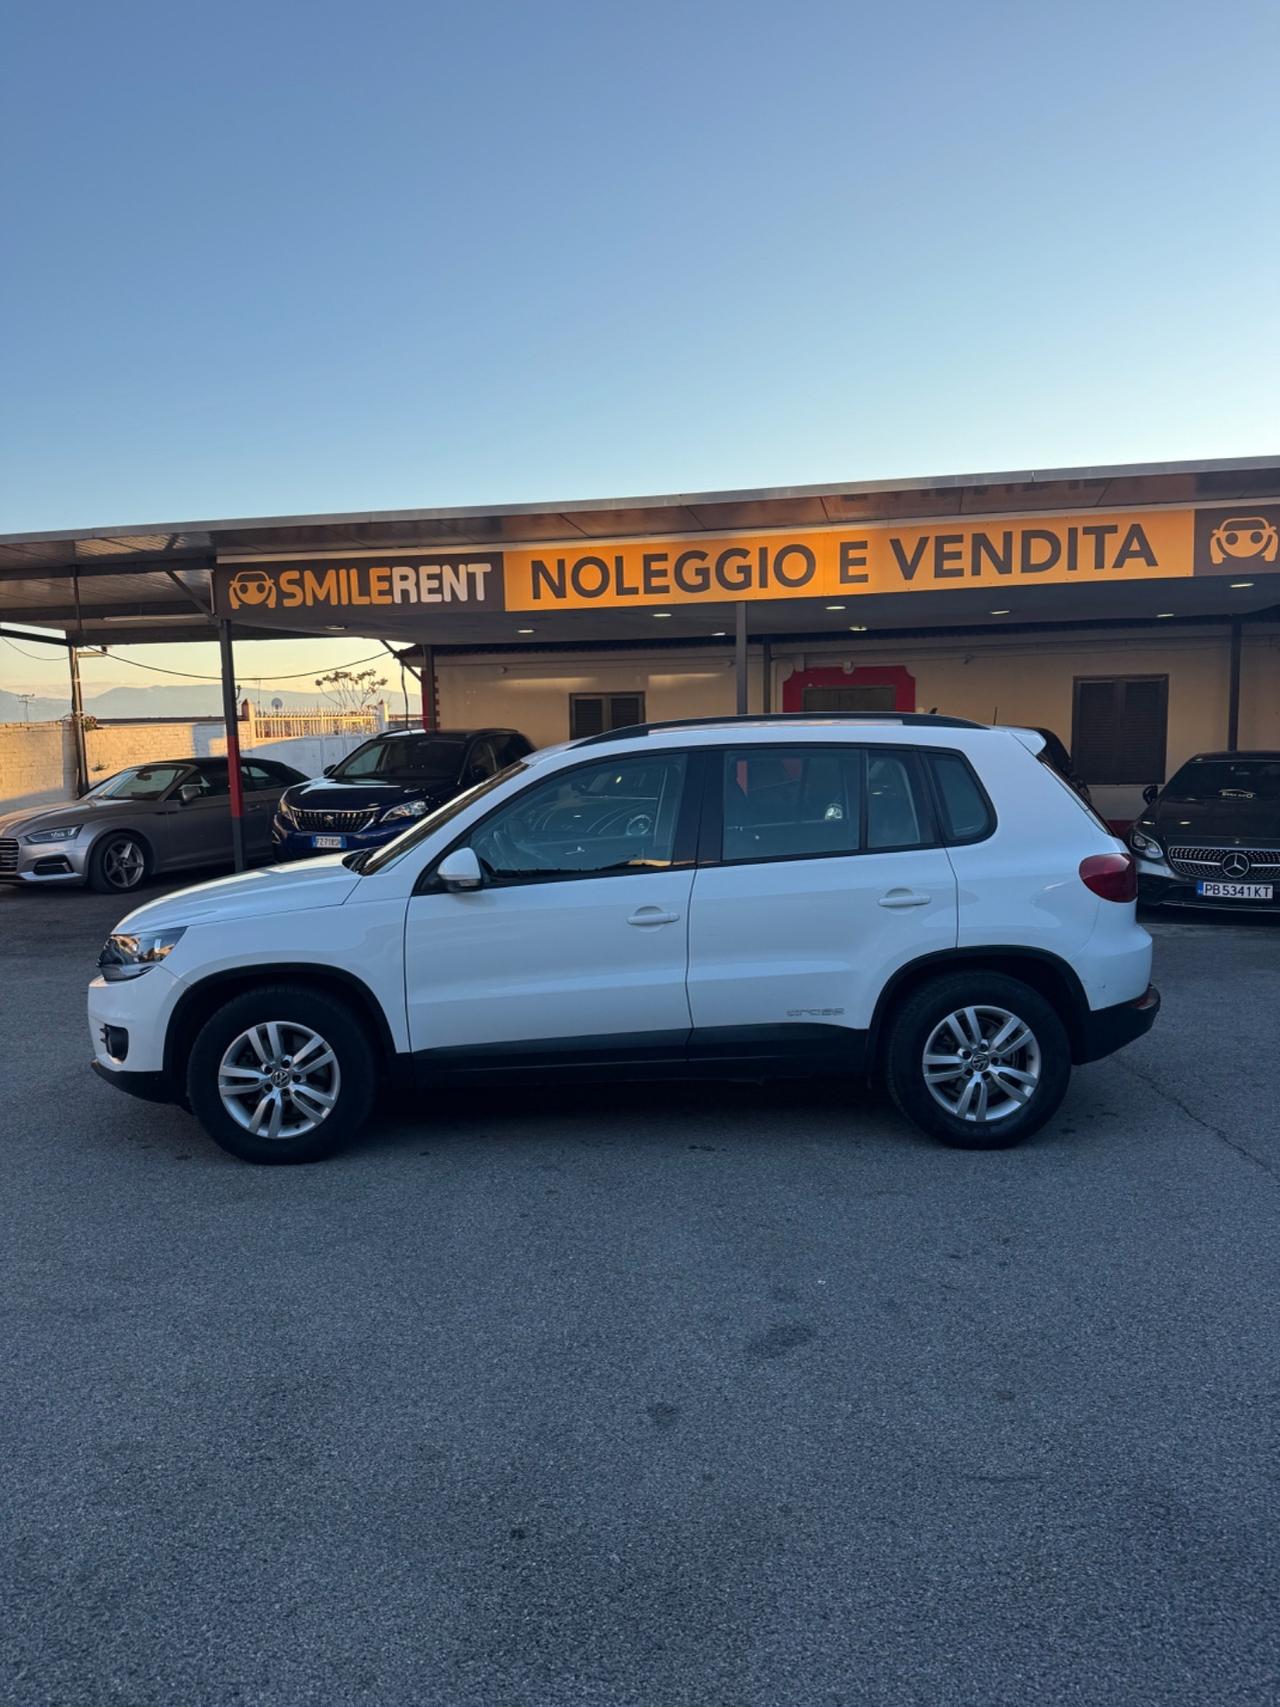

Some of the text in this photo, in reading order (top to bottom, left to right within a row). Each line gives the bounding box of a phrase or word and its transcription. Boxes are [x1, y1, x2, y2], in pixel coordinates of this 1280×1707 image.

[279, 563, 492, 608] SMILERENT
[531, 523, 1158, 600] NOLEGGIO E VENDITA
